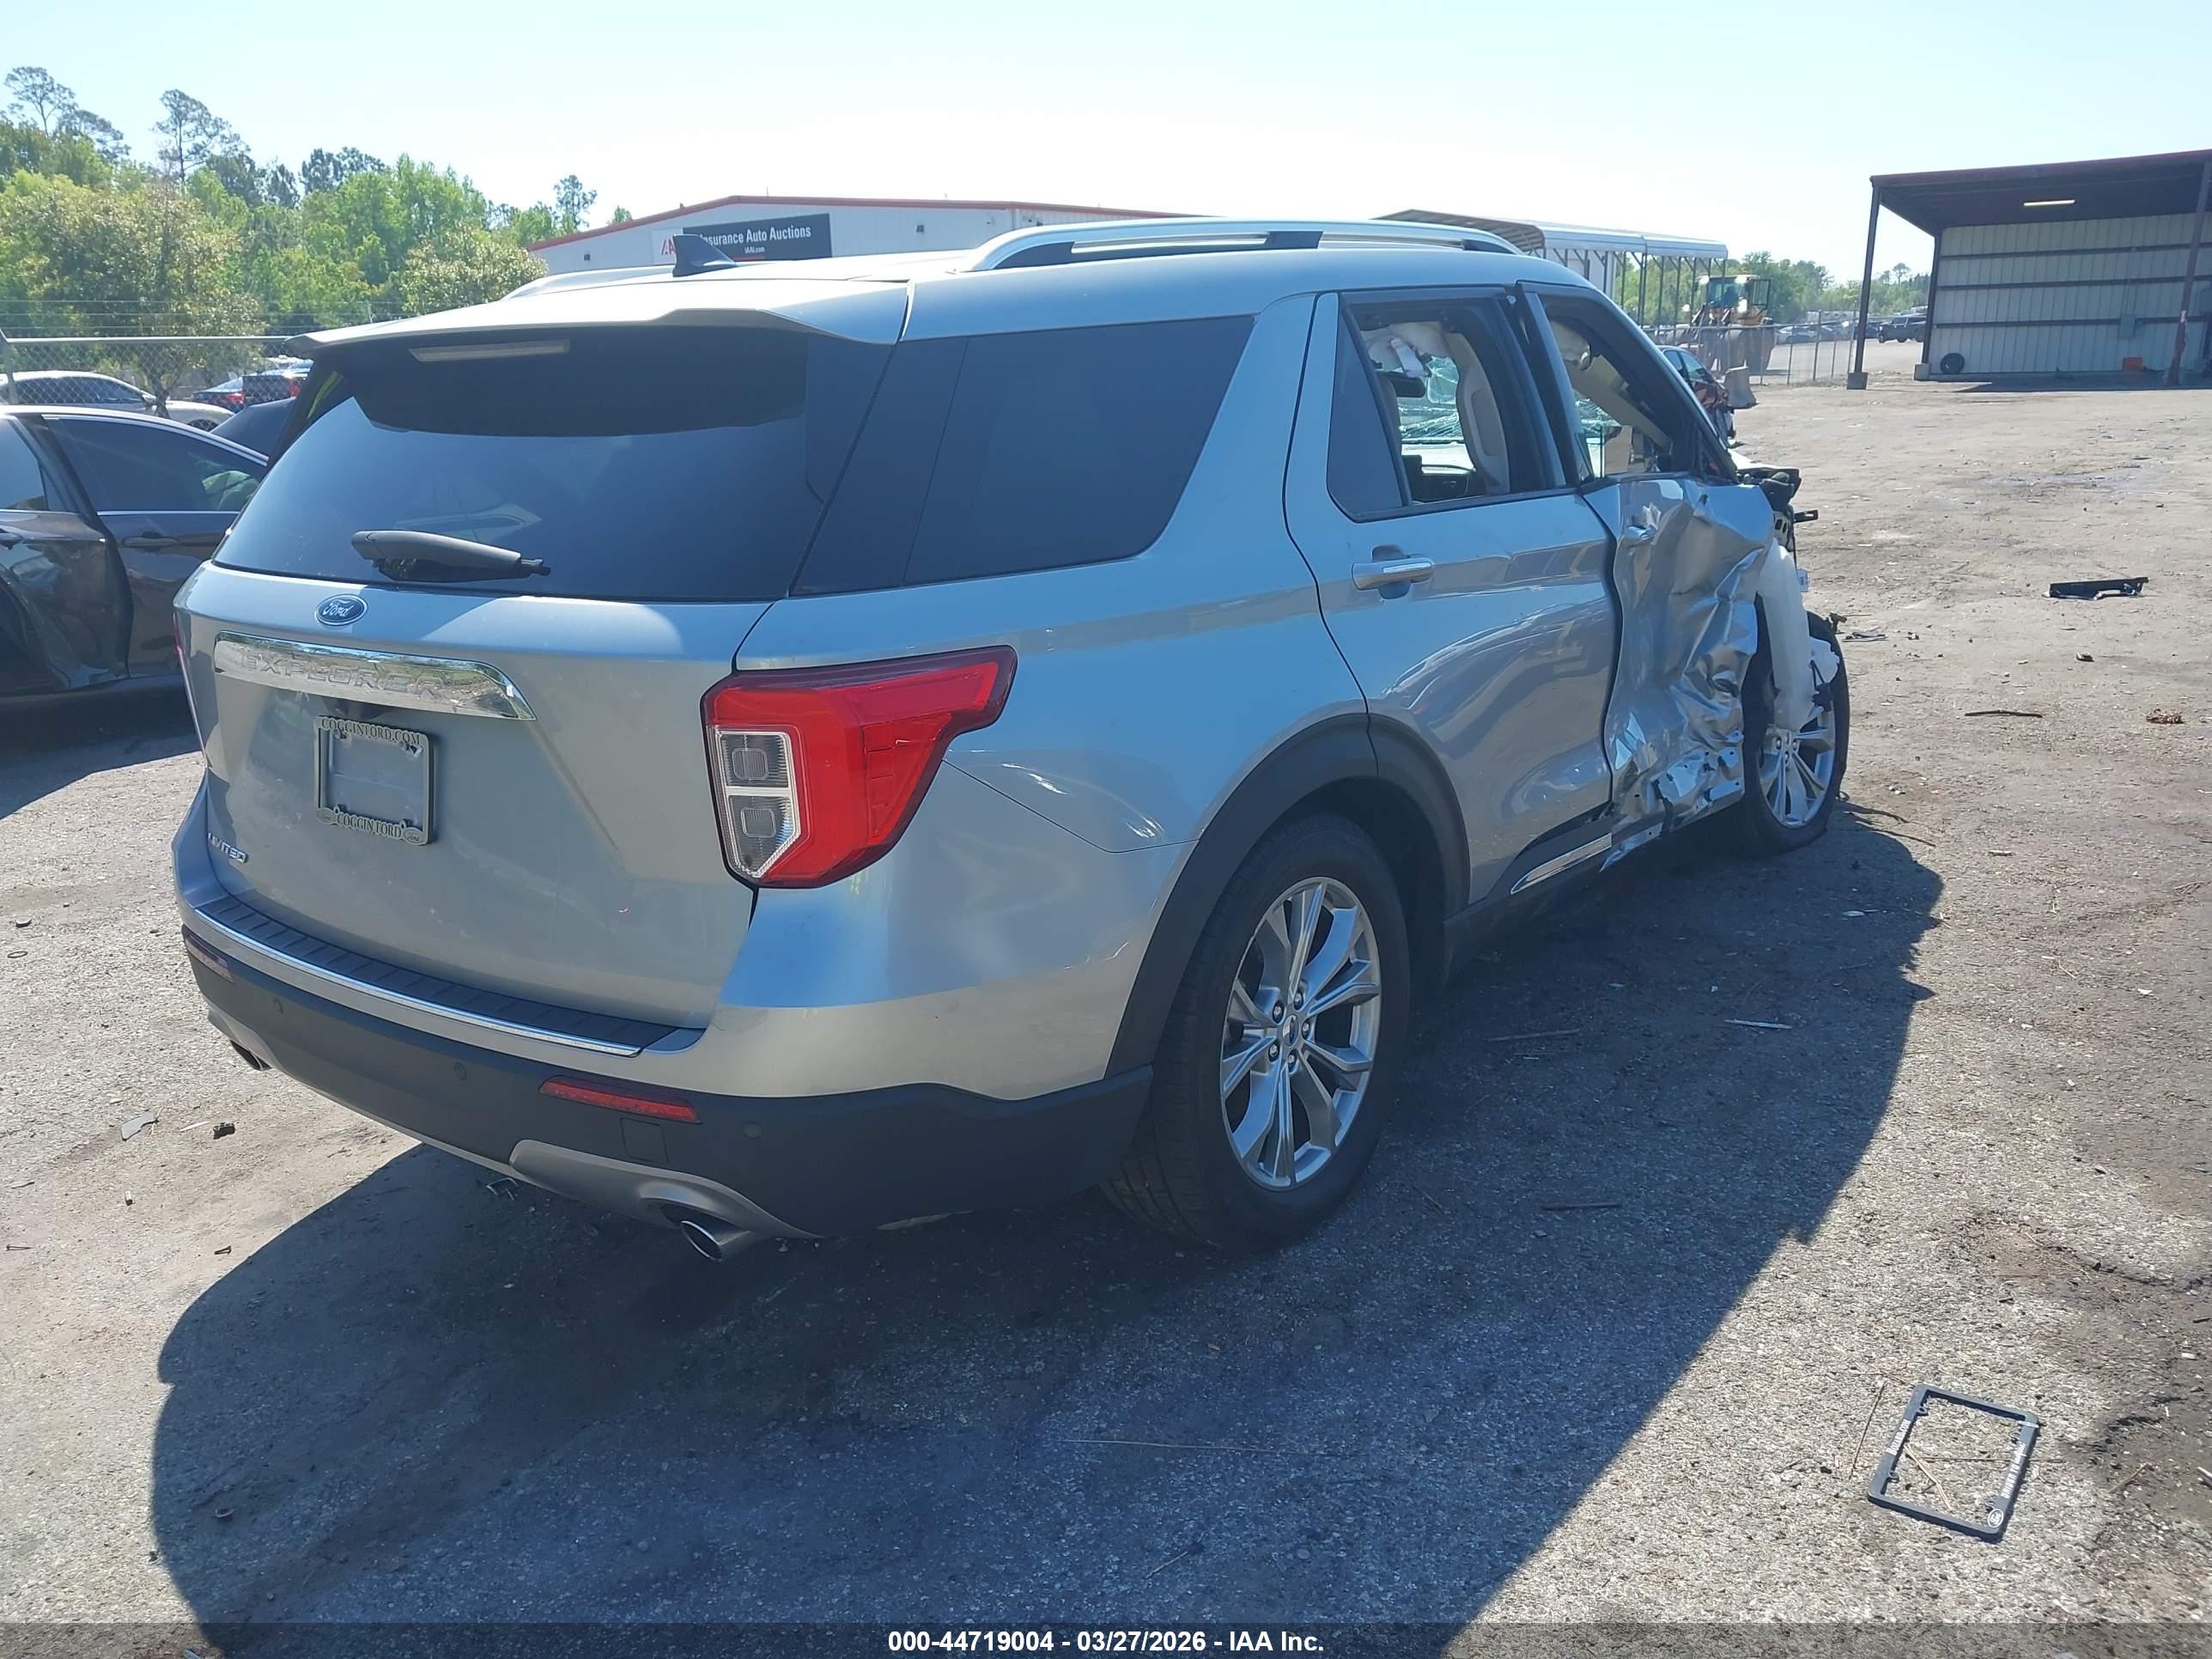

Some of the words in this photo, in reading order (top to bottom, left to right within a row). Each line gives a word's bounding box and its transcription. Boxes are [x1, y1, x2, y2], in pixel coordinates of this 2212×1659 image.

[746, 228, 767, 243] Auto
[769, 224, 811, 241] Auctions
[322, 599, 355, 617] Ford
[241, 655, 445, 699] EXPLORER
[321, 717, 421, 745] COGGINFORD.COM
[337, 814, 374, 833] COGGIN
[375, 824, 402, 839] FORD
